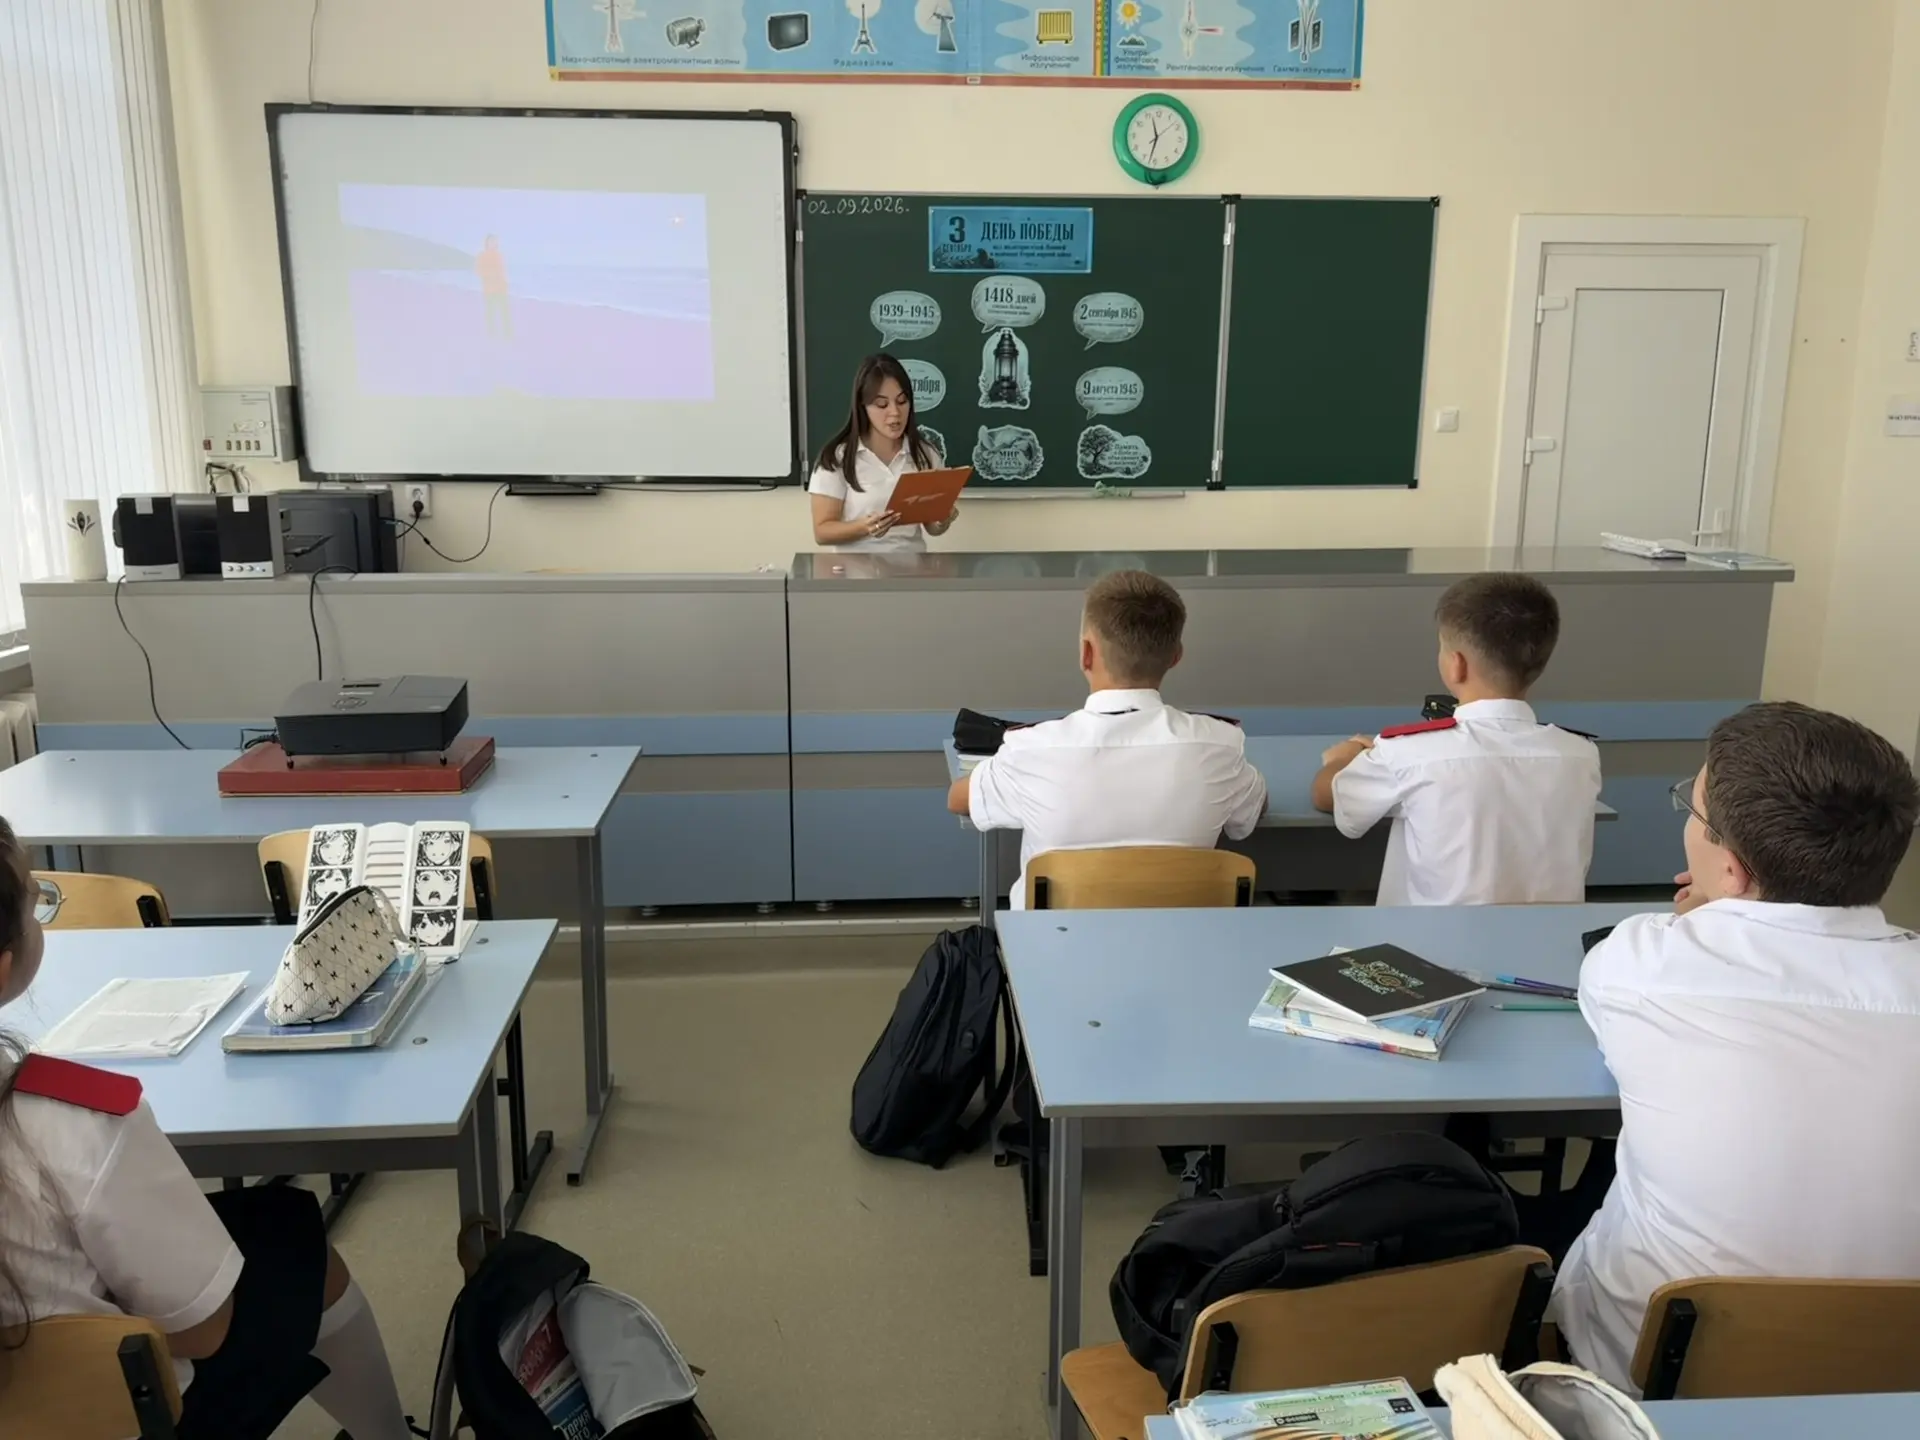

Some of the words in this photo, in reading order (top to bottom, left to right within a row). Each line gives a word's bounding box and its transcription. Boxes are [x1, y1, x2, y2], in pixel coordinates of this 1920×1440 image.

[1021, 54, 1080, 63] Инфракрасное
[1166, 63, 1223, 72] Рентгеновское
[808, 196, 910, 215] 02.09.2026.
[949, 216, 966, 243] 3
[980, 221, 1016, 242] ДЕНЬ
[1020, 223, 1074, 242] ПОБЕДЫ
[984, 287, 1013, 303] 1418
[1016, 292, 1037, 304] дней
[1080, 303, 1088, 320] 2
[1089, 307, 1119, 320] сентября
[1121, 307, 1138, 319] 1945
[1083, 381, 1091, 395] 9
[1092, 385, 1119, 395] августа
[1120, 383, 1138, 395] 1945
